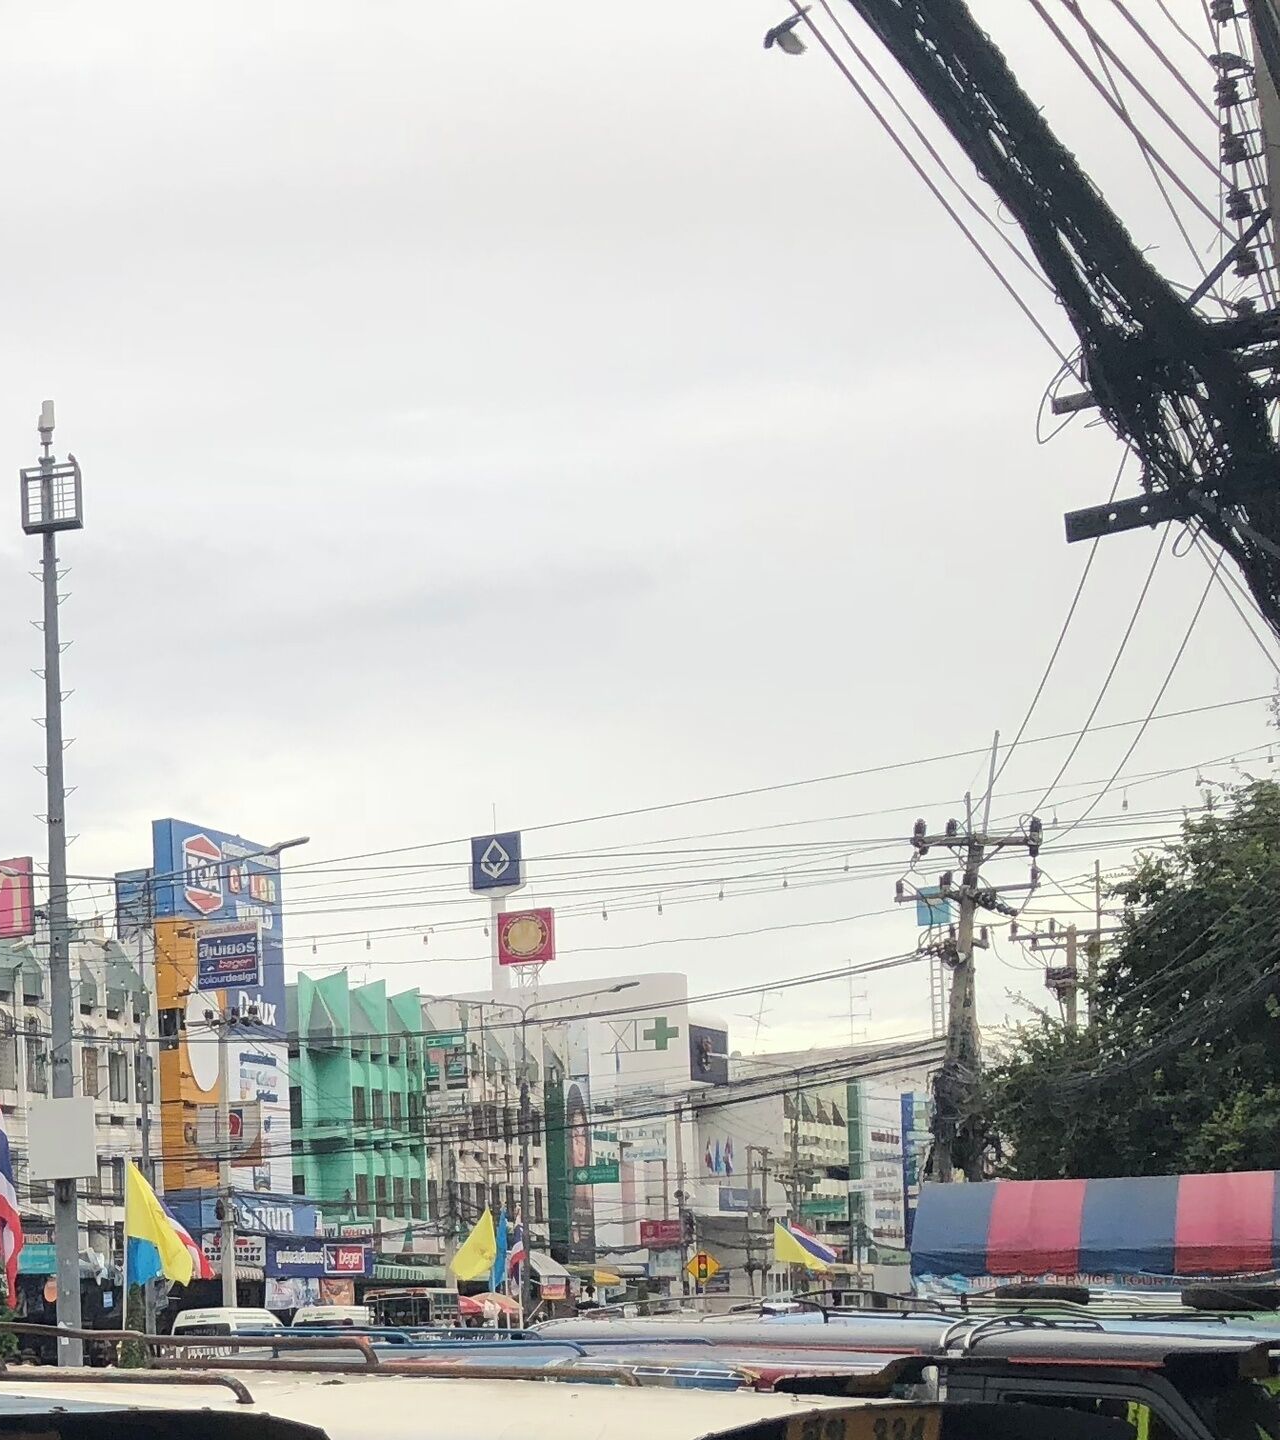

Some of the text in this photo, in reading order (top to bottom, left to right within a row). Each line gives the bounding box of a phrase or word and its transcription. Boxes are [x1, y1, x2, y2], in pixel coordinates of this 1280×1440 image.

[339, 1249, 362, 1270] beger
[1043, 1273, 1115, 1286] SERVICE
[1120, 1274, 1164, 1287] TOUR
